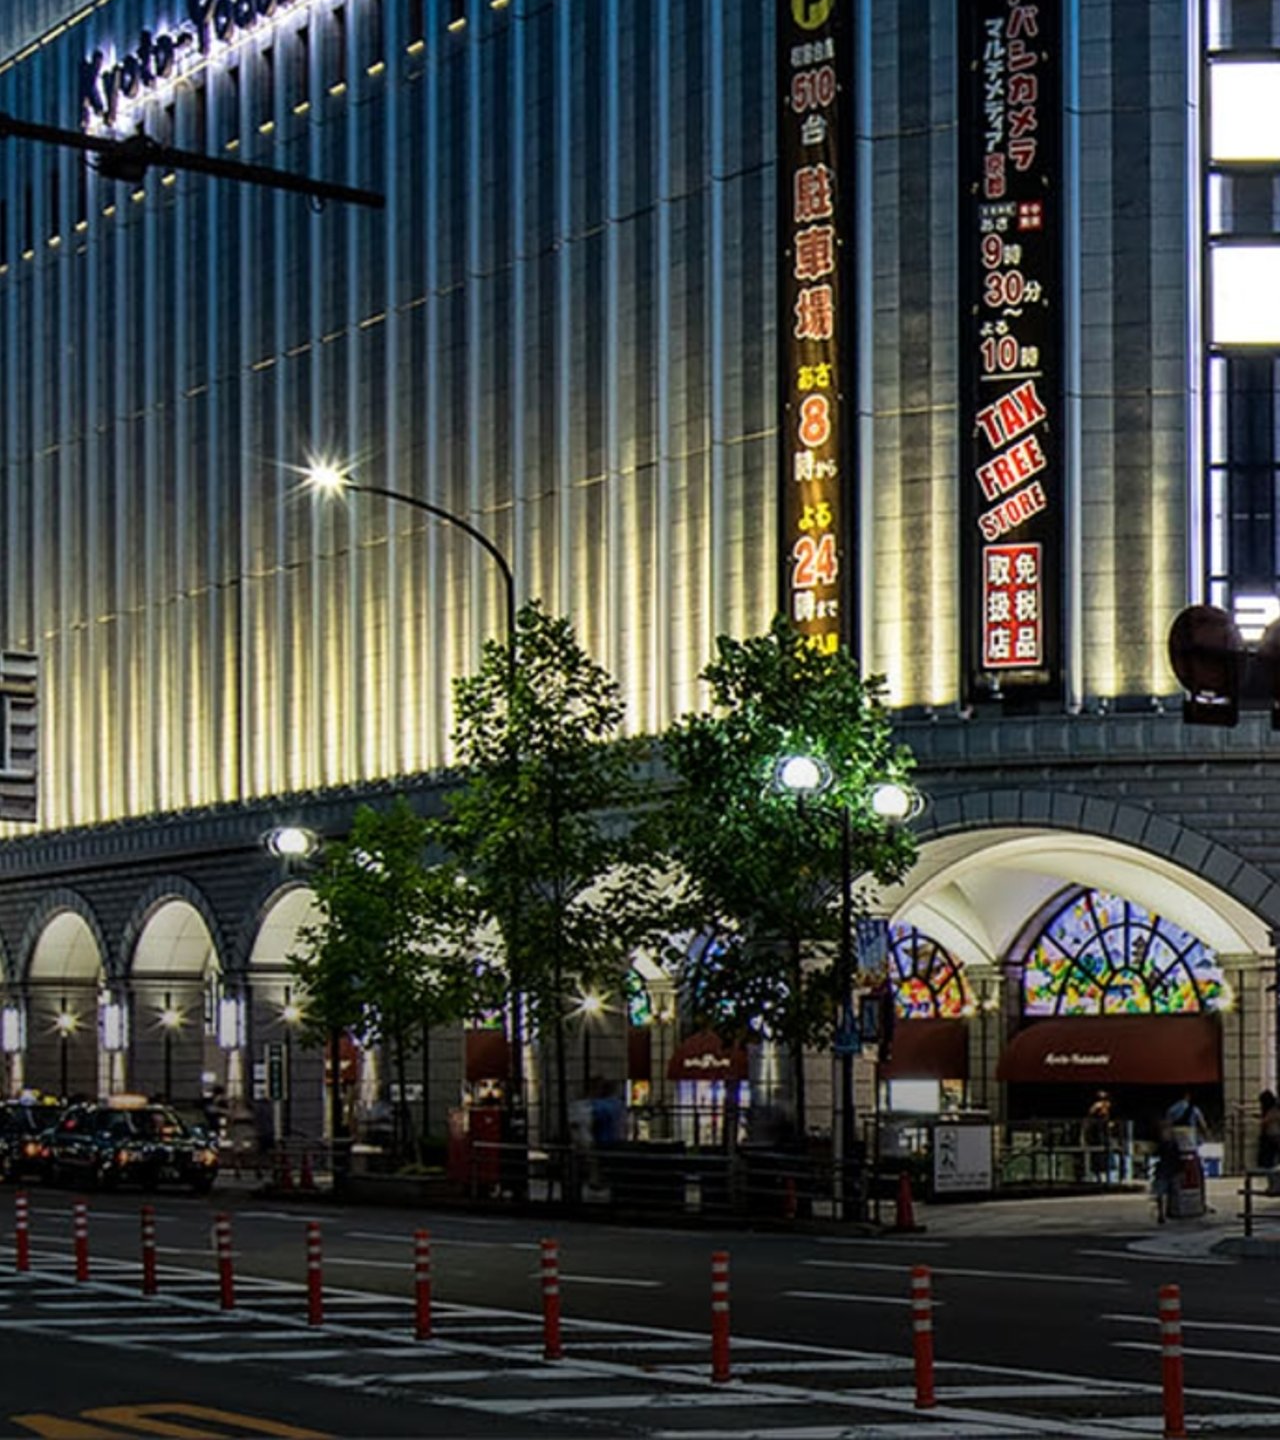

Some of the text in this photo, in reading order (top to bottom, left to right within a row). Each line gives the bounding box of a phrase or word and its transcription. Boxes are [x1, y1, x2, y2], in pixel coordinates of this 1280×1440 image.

[791, 64, 835, 113] 510
[801, 112, 827, 146] 台
[793, 162, 837, 340] 駐車場
[984, 270, 1042, 307] 30分
[798, 363, 832, 390] あさ
[799, 392, 831, 448] 8
[976, 379, 1047, 449] TAX
[976, 434, 1047, 502] FREE
[798, 501, 833, 531] よる
[978, 480, 1047, 543] STORE
[793, 534, 838, 590] 24
